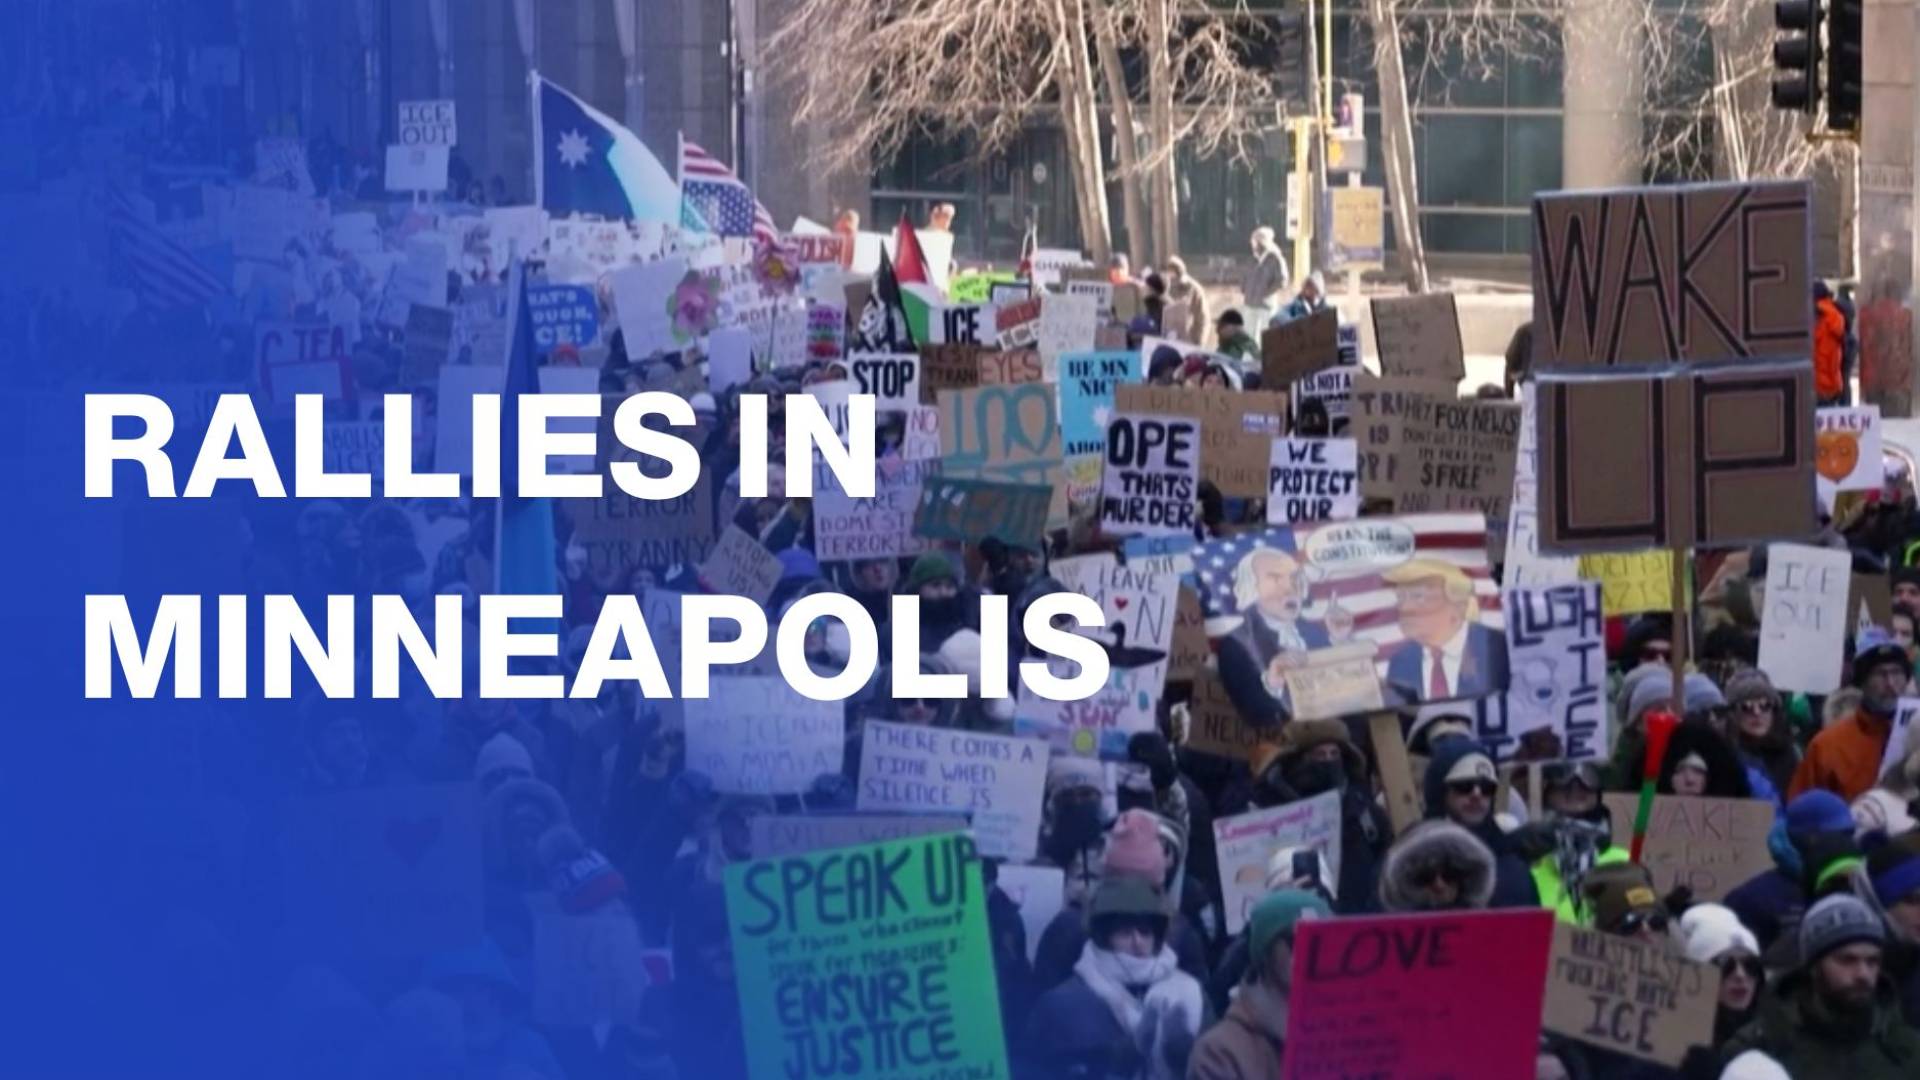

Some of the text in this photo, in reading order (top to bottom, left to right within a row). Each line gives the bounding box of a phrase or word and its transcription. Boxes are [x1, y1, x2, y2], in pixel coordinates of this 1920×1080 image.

[403, 104, 450, 125] ICE
[402, 125, 451, 146] OUT
[1534, 185, 1808, 366] WAKE
[943, 304, 982, 346] ICE
[853, 360, 915, 399] STOP
[981, 351, 1042, 385] EYES
[1068, 359, 1130, 377] BE MN
[1318, 372, 1341, 391] NOT
[1343, 371, 1352, 388] A
[911, 409, 938, 433] NO
[1434, 403, 1469, 430] FOX
[1472, 406, 1518, 435] NEWS
[1109, 418, 1193, 469] OPE
[1288, 441, 1327, 464] WE
[1553, 374, 1798, 545] UP
[1119, 470, 1193, 502] THATS
[1270, 467, 1356, 495] PROTECT
[1103, 497, 1194, 529] MURDER
[1287, 499, 1333, 521] OUR
[1099, 562, 1156, 595] LEAVE
[1774, 561, 1834, 596] ICE
[1058, 701, 1119, 727] SUN
[871, 724, 938, 754] THERE
[951, 735, 1011, 761] COMES
[1020, 744, 1034, 763] A
[874, 755, 997, 785] TIME WHEN
[864, 778, 992, 810] SILENCE IS
[742, 833, 982, 938] SPEAK UP
[1303, 922, 1461, 984] LOVE
[775, 962, 950, 1027] ENSURE
[1583, 994, 1658, 1052] ICE
[783, 1012, 961, 1080] JUSTICE
